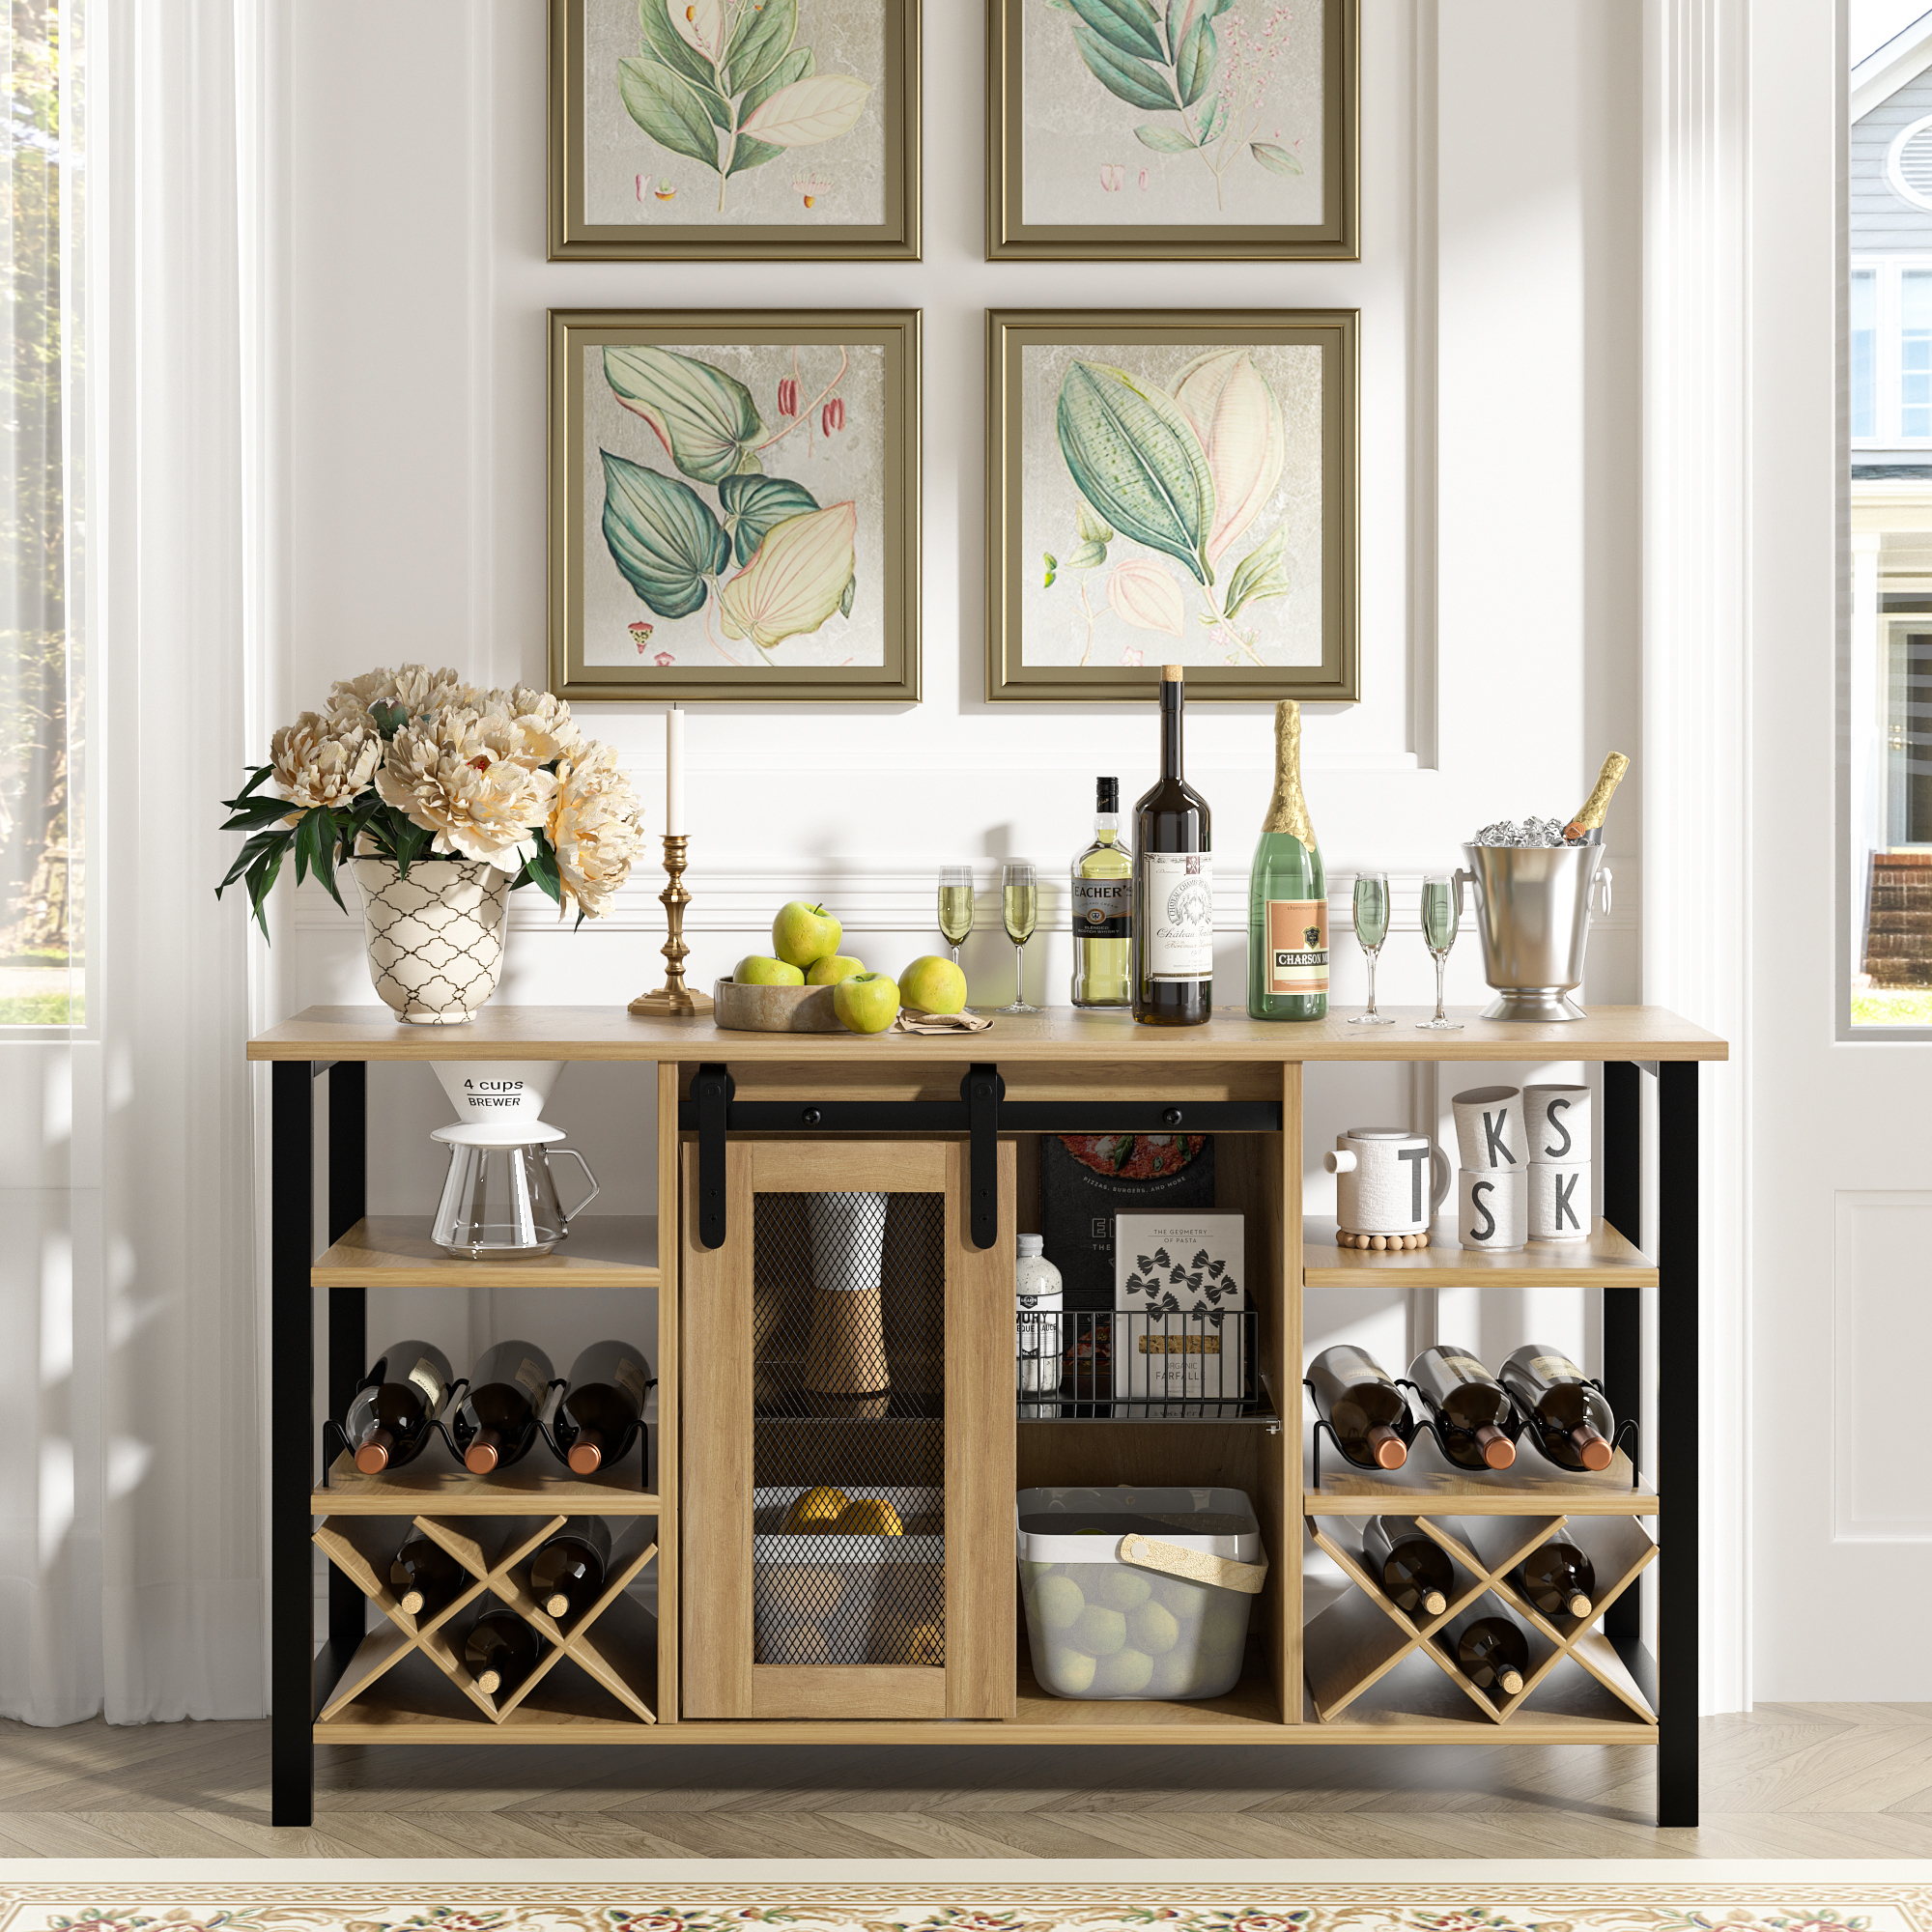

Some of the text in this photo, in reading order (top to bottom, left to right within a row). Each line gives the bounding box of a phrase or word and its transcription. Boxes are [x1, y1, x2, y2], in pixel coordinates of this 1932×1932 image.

[1278, 952, 1321, 965] CHARSON
[464, 1078, 524, 1093] 4 cups
[468, 1097, 521, 1107] BREWER
[1545, 1098, 1572, 1158] S
[1483, 1108, 1518, 1168] K
[1167, 1176, 1186, 1187] MORE
[1398, 1147, 1430, 1223] T
[1555, 1173, 1581, 1231] K
[1469, 1180, 1495, 1241] S
[1038, 1323, 1057, 1332] AUCE
[1155, 1372, 1206, 1380] FARFLL
